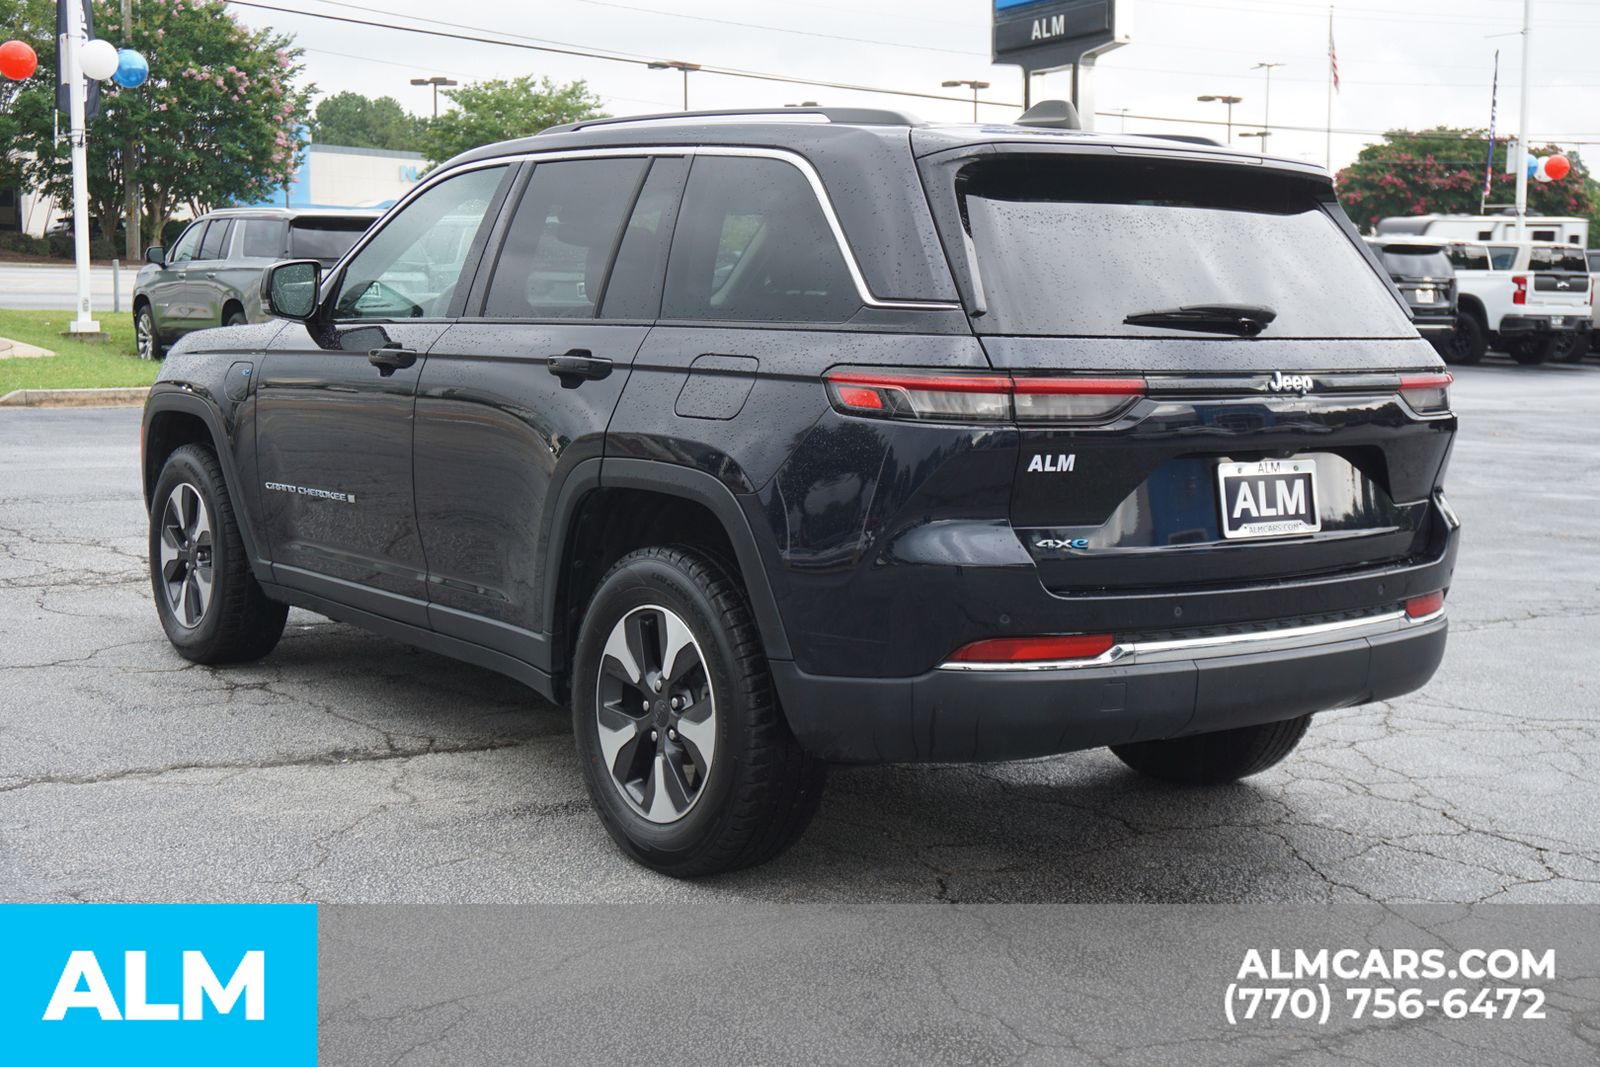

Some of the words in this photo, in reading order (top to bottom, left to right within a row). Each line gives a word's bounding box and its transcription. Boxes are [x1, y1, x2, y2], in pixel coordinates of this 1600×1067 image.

[1031, 14, 1065, 40] ALM
[1270, 371, 1313, 395] Jeep
[1027, 454, 1076, 473] ALM
[1258, 462, 1281, 474] ALM
[265, 482, 296, 493] GRAND
[297, 487, 347, 502] CHEROKEE
[1232, 479, 1306, 518] ALM
[1249, 523, 1300, 535] ALMCARS.COM
